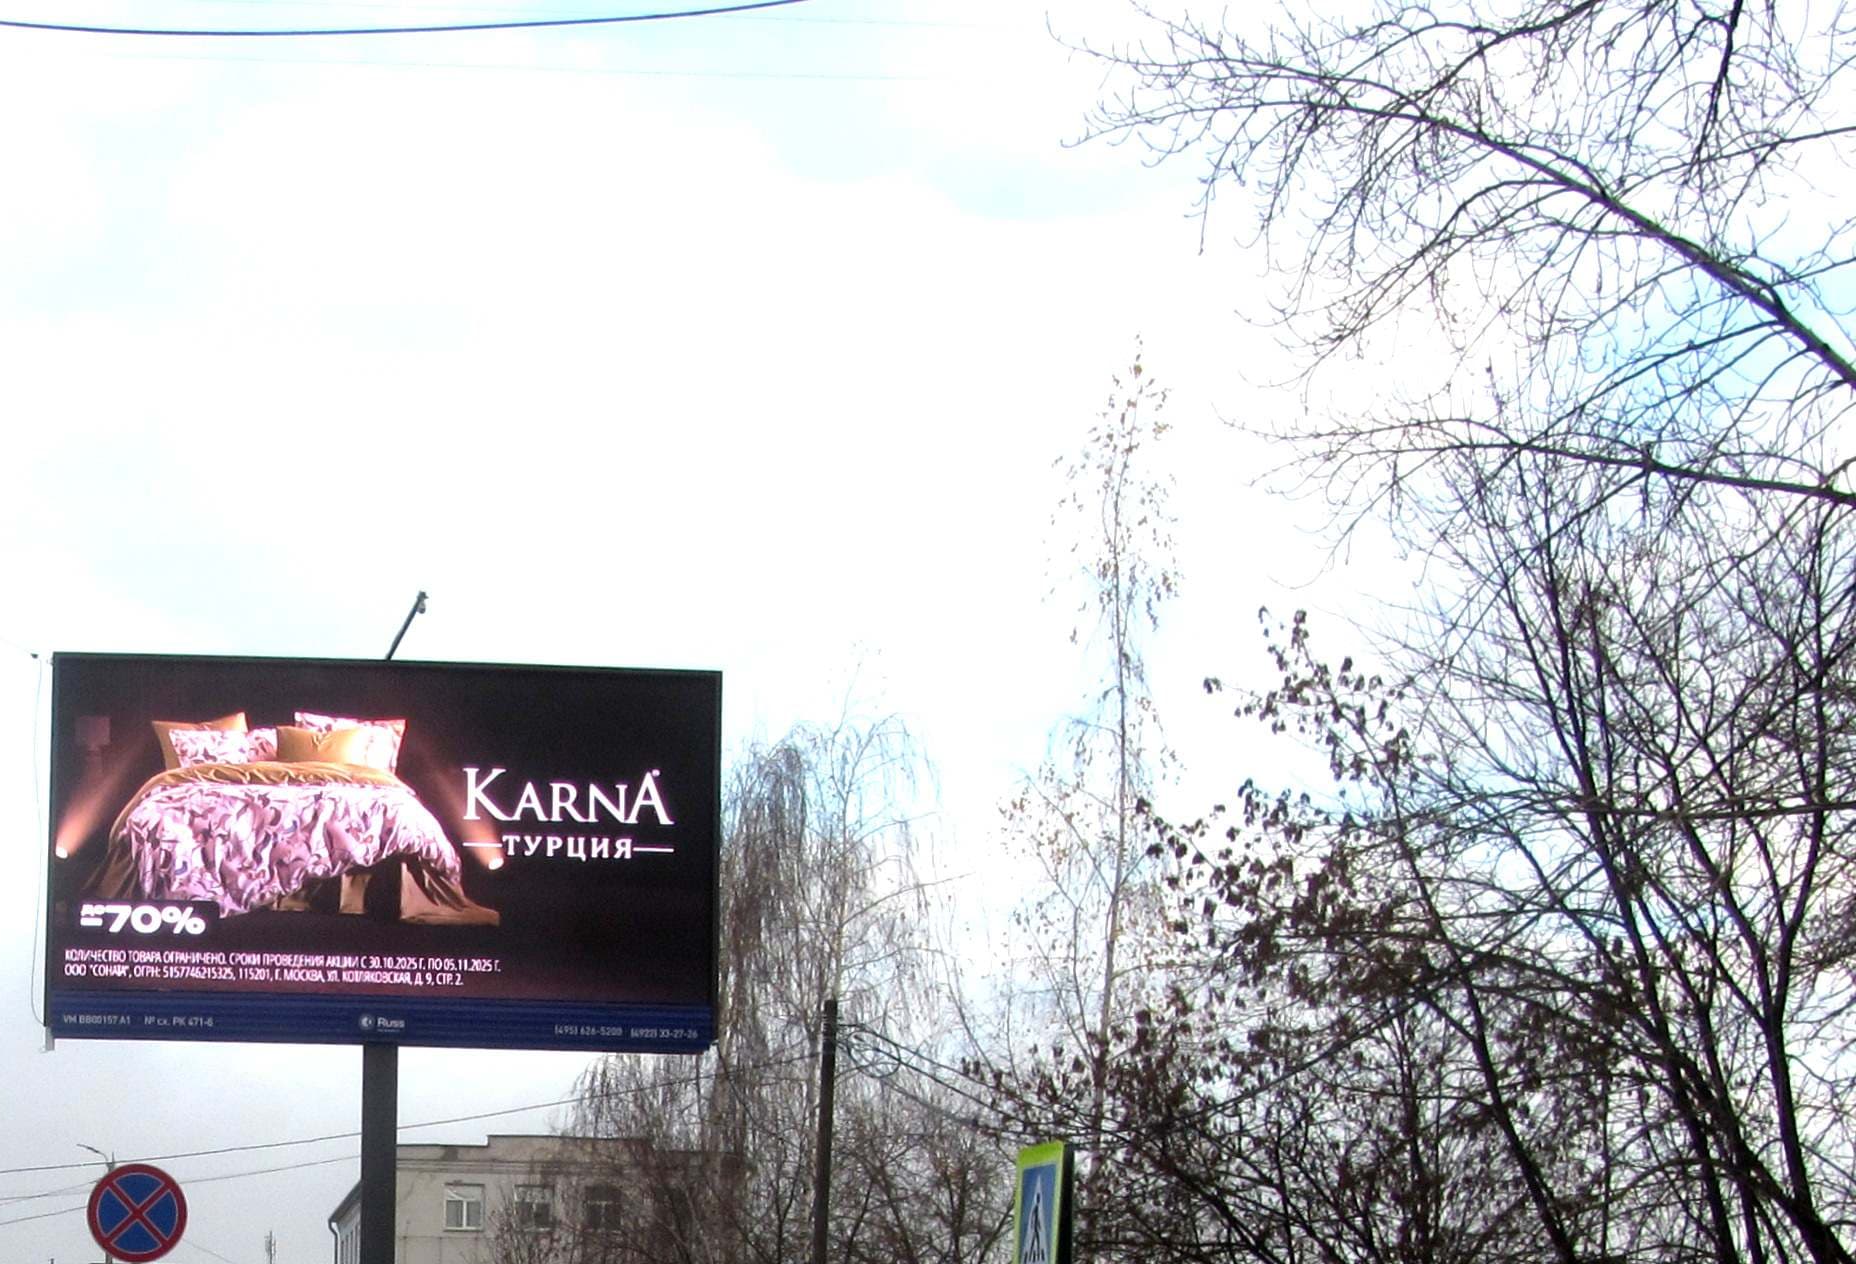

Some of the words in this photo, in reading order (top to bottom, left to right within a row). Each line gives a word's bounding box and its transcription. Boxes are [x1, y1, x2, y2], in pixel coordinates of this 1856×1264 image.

[501, 834, 633, 862] ТУРЦИЯ
[64, 949, 126, 962] КОЛИЧЕСТВО
[128, 950, 162, 963] ТОВАРА
[163, 951, 226, 966] ОГРАНИЧЕНО.
[229, 952, 261, 966] СРОКИ
[263, 953, 325, 968] ПРОВЕДЕНИЯ
[326, 955, 358, 968] АКЦИИ
[360, 956, 367, 969] С
[369, 956, 417, 970] 30.10.2025
[418, 957, 426, 970] Г.
[428, 958, 442, 971] ПО
[443, 958, 492, 972] 05.11.2025
[494, 960, 501, 972] Г.
[64, 963, 86, 976] ООО
[133, 965, 161, 978] ОГРН:
[239, 967, 273, 981] 115201,
[327, 970, 340, 982] УЛ.
[377, 1016, 405, 1028] Russ
